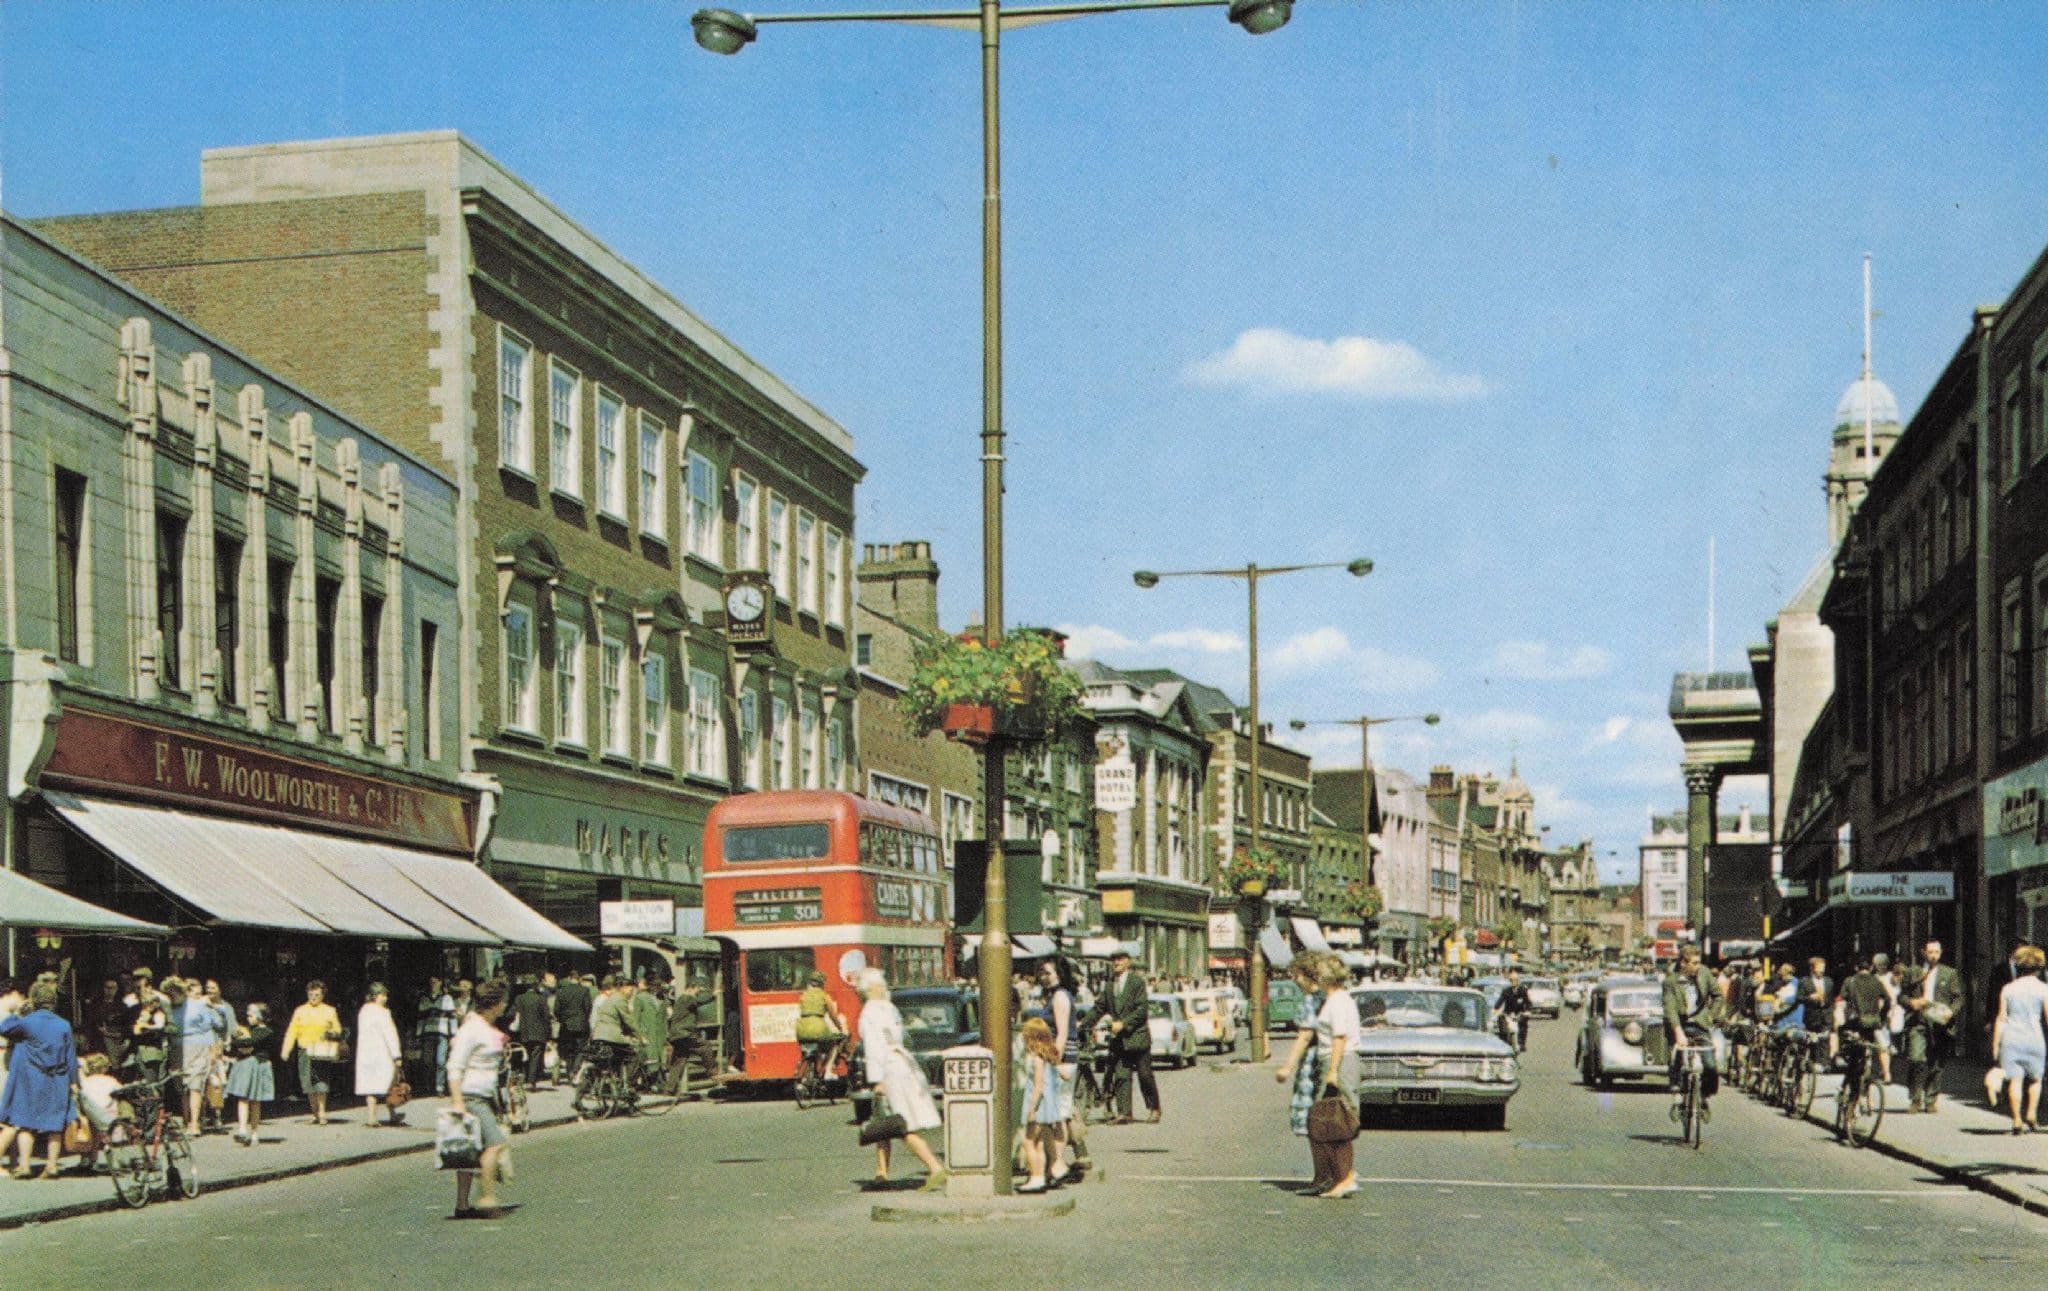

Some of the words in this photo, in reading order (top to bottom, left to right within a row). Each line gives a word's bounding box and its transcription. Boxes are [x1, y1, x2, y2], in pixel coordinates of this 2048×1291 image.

[155, 741, 172, 784] F.
[182, 746, 209, 790] W.
[216, 754, 340, 815] WOOLWORTH
[349, 795, 359, 817] &
[1098, 769, 1132, 779] GRAND
[1098, 782, 1131, 793] HOTEL
[576, 819, 669, 862] MARKS
[1891, 874, 1908, 885] THE
[1851, 886, 1906, 897] CAMPBELL
[1915, 885, 1949, 896] HOTEL
[793, 904, 819, 921] 301
[947, 1060, 989, 1074] KEEP
[949, 1075, 986, 1090] LEFT
